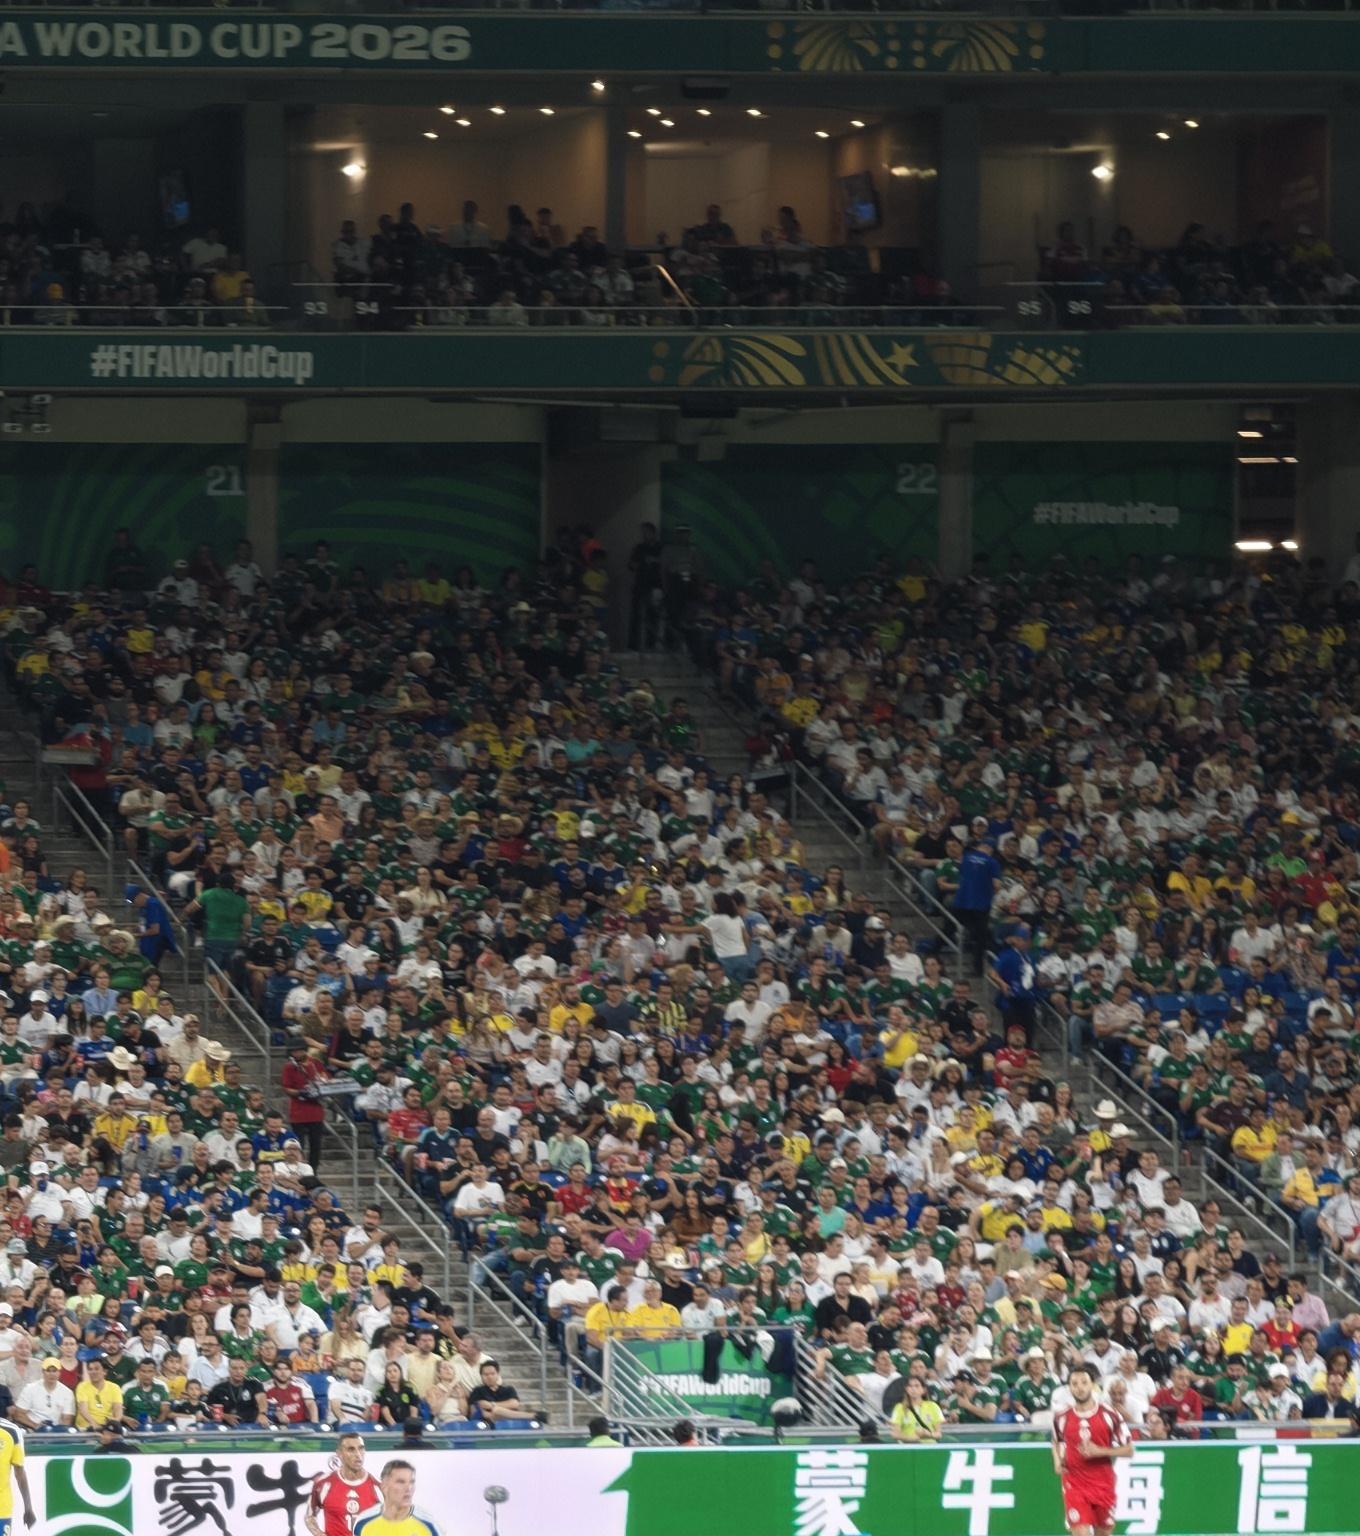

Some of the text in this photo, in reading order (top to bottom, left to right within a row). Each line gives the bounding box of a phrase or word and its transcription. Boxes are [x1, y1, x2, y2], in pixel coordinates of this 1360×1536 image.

[32, 22, 202, 58] WORLD
[210, 22, 302, 58] CUP
[310, 23, 472, 61] 2026
[304, 301, 328, 315] 93
[355, 301, 380, 315] 94
[90, 344, 315, 385] #FIFAWorldCup
[205, 465, 246, 497] 21
[896, 462, 939, 495] 22
